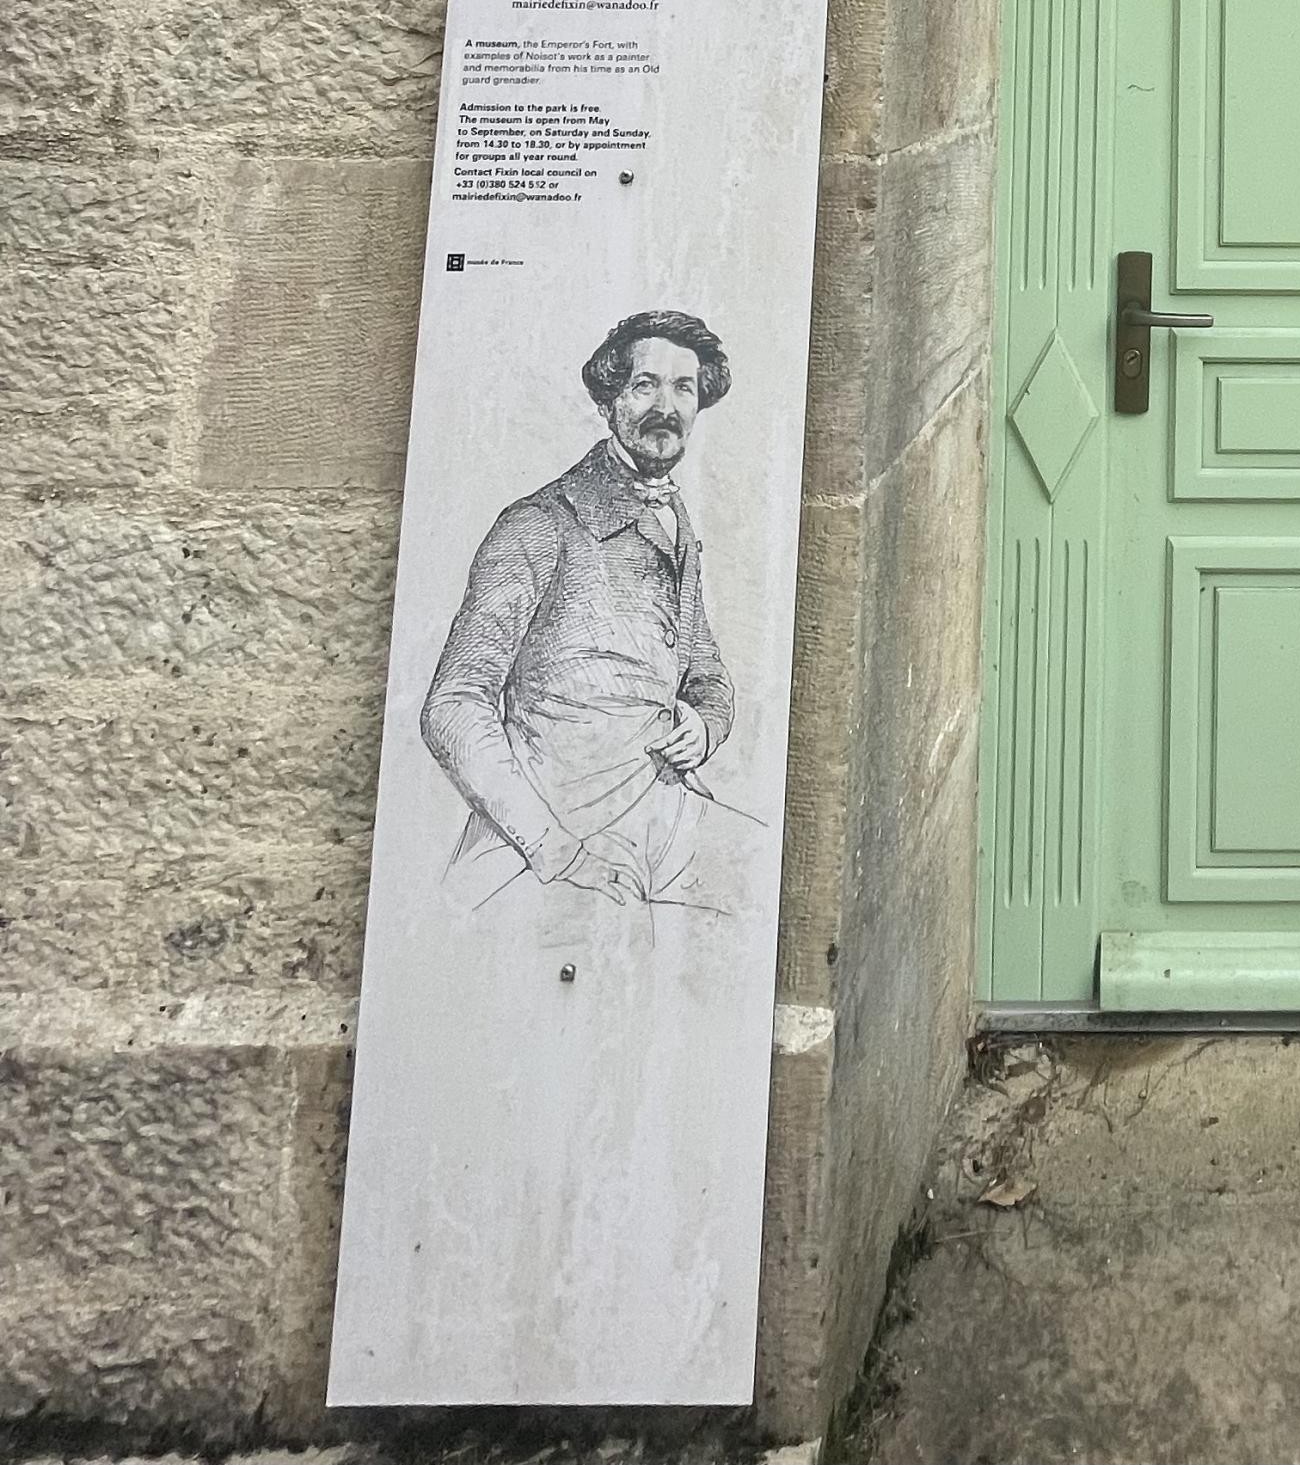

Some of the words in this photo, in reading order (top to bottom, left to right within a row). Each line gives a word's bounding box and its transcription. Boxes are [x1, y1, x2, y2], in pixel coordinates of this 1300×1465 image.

[512, 0, 659, 10] mairiedefixin@wanadoo.fr
[475, 41, 520, 49] museum,
[523, 40, 538, 48] the
[541, 40, 590, 50] Emperor's
[592, 41, 615, 49] Fort,
[464, 53, 510, 62] examples
[513, 52, 525, 60] of
[616, 54, 649, 62] painter
[573, 65, 588, 73] his
[591, 65, 612, 73] time
[462, 76, 491, 85] guard
[460, 104, 511, 112] Admission
[514, 104, 524, 112] to
[528, 104, 543, 112] the
[546, 104, 567, 114] park
[459, 116, 477, 124] The
[525, 116, 533, 124] is
[536, 118, 560, 126] open
[563, 116, 586, 124] from
[589, 117, 609, 127] May
[471, 128, 527, 138] September,
[545, 129, 589, 138] Saturday
[592, 129, 610, 137] and
[456, 140, 479, 148] from
[569, 141, 580, 151] by
[583, 142, 645, 151] appointment
[456, 152, 469, 160] for
[472, 153, 506, 162] groups
[524, 154, 544, 163] year
[547, 153, 577, 161] round.
[454, 168, 492, 176] Contact
[495, 168, 518, 176] Fixin
[522, 168, 544, 176] local
[477, 180, 506, 189] (0)380
[452, 193, 582, 202] mairiedefixin@wanadoo.fr
